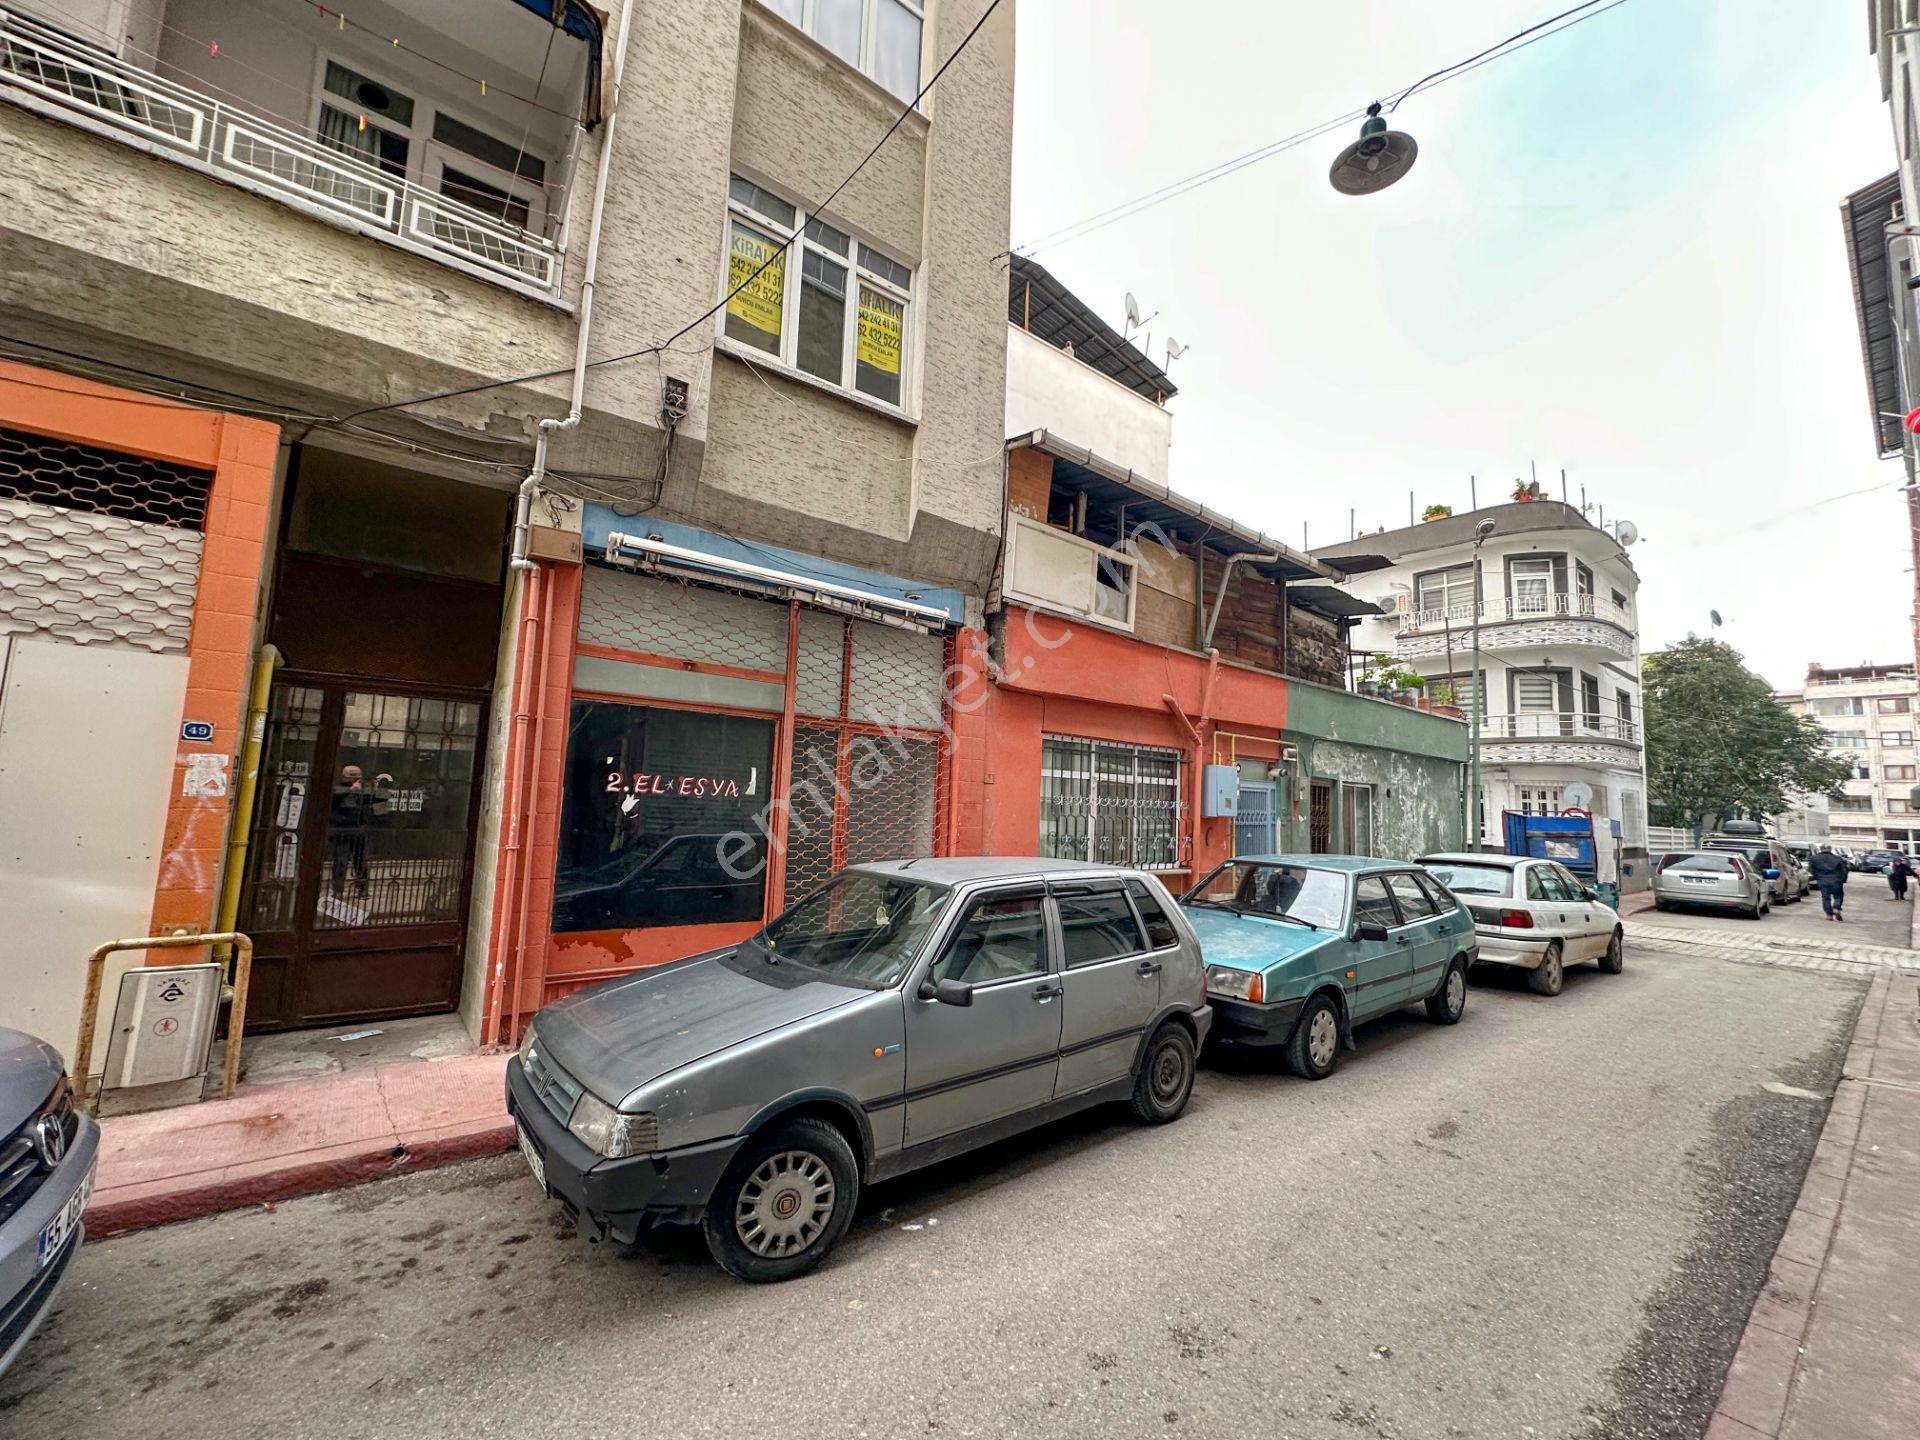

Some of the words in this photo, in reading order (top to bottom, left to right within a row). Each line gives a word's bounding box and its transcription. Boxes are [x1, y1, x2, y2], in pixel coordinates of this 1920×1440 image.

[762, 270, 771, 284] 41
[869, 327, 882, 344] 432
[187, 726, 207, 735] 49
[45, 1213, 62, 1258] 55
